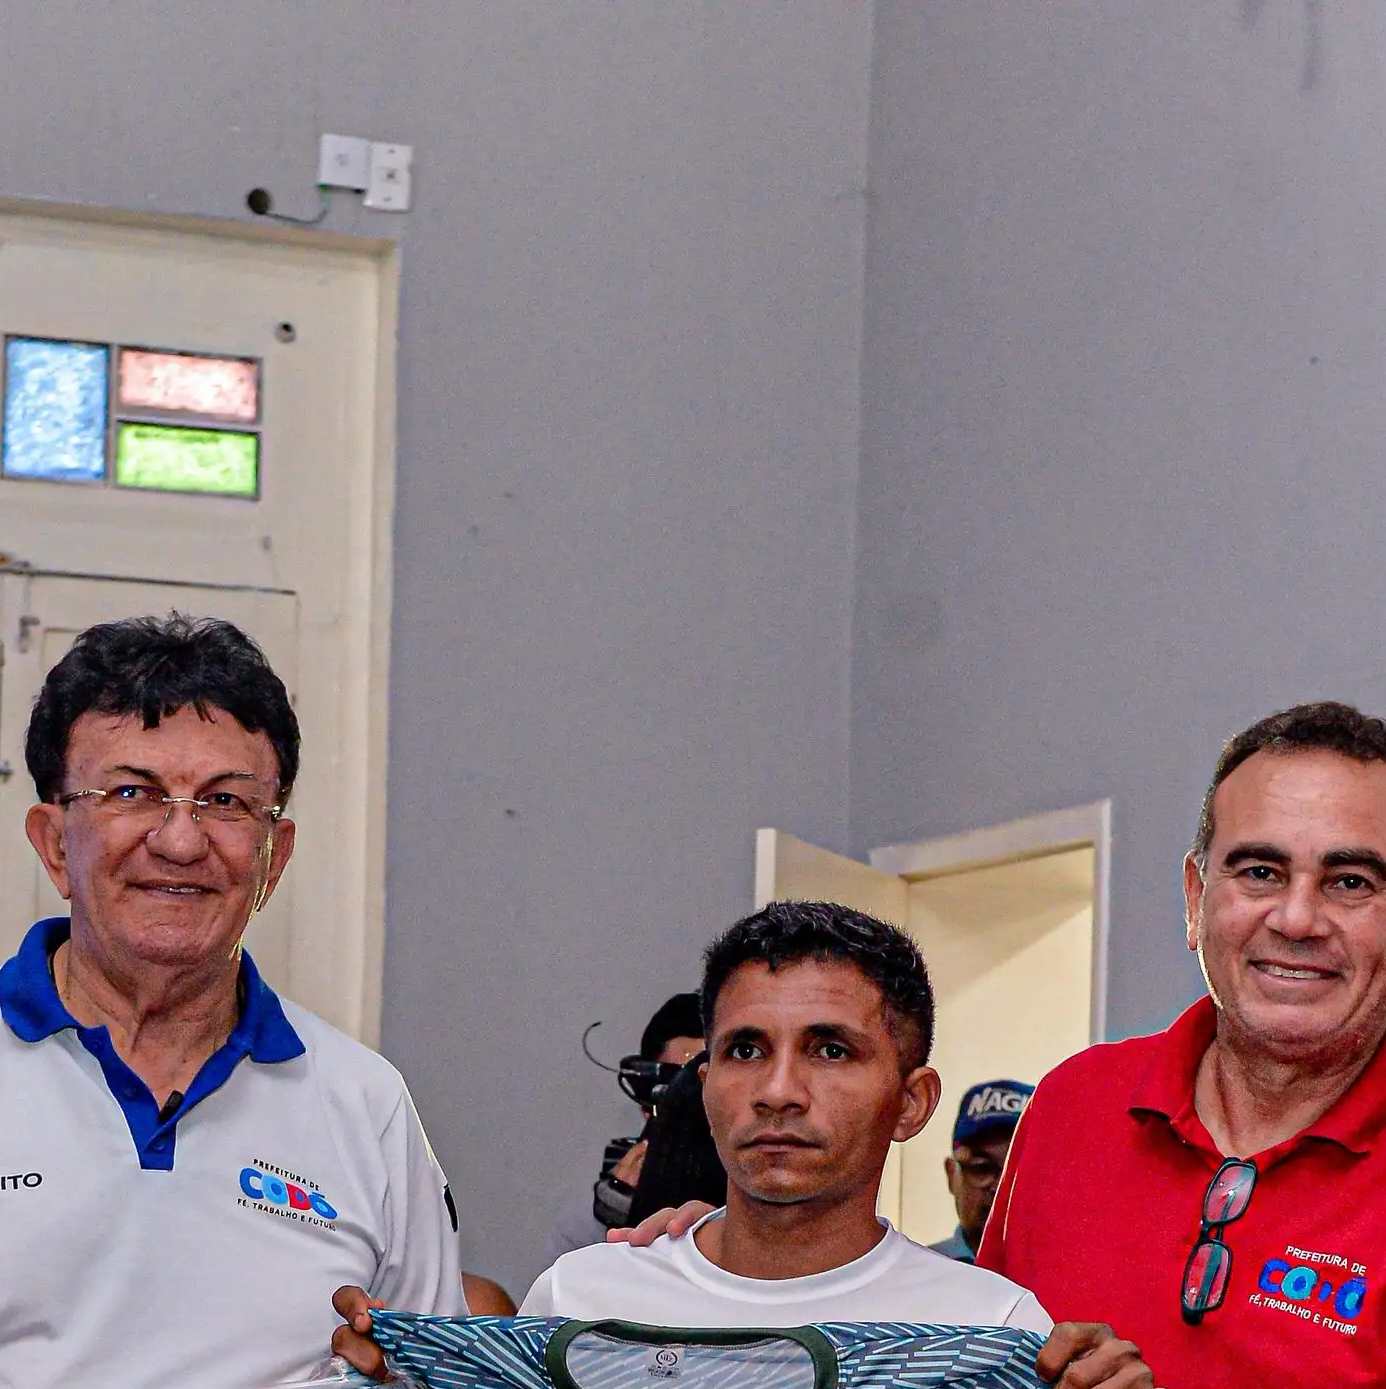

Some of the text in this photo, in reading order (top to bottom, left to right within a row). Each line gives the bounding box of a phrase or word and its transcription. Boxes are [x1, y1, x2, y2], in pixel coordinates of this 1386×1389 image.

[253, 1158, 320, 1191] PREFEITURA DE
[253, 1202, 298, 1220] TRABALHO
[300, 1215, 305, 1223] E
[1285, 1245, 1367, 1276] PREFEITURA DE
[1263, 1297, 1311, 1320] TRABALHO
[1313, 1313, 1321, 1324] E
[1322, 1317, 1357, 1336] FUTURO
